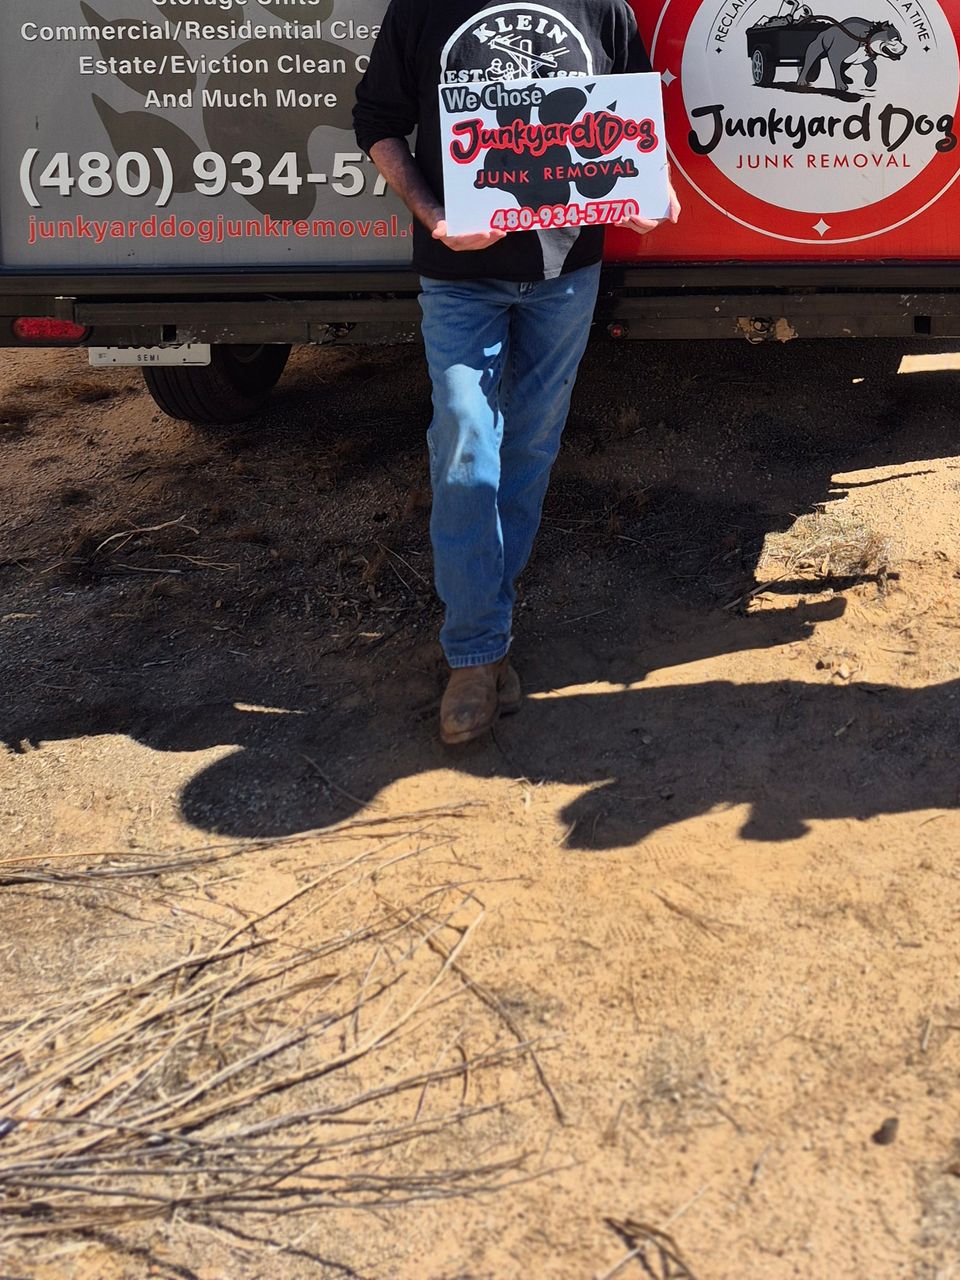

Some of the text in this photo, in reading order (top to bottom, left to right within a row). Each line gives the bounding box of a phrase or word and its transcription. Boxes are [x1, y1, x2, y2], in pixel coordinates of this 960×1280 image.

[20, 20, 322, 42] Commercial/Residential
[471, 14, 568, 45] KLEIN
[901, 2, 913, 13] A
[909, 10, 930, 42] TIME
[79, 55, 269, 75] Estate/Eviction
[277, 54, 347, 74] Clean
[446, 69, 485, 84] EST.
[144, 89, 338, 109] And Much More
[444, 84, 543, 111] We Chose
[451, 113, 658, 162] Junkyard Dog
[687, 102, 958, 155] Junkyard Dog
[477, 161, 636, 185] JUNK REMOVAL
[736, 153, 911, 170] JUNK REMOVAL
[19, 147, 175, 208] (480)
[491, 201, 636, 229] 480-934-5770
[28, 214, 413, 244] junkyarddogjunkremoval.
[137, 354, 160, 362] SEMI
